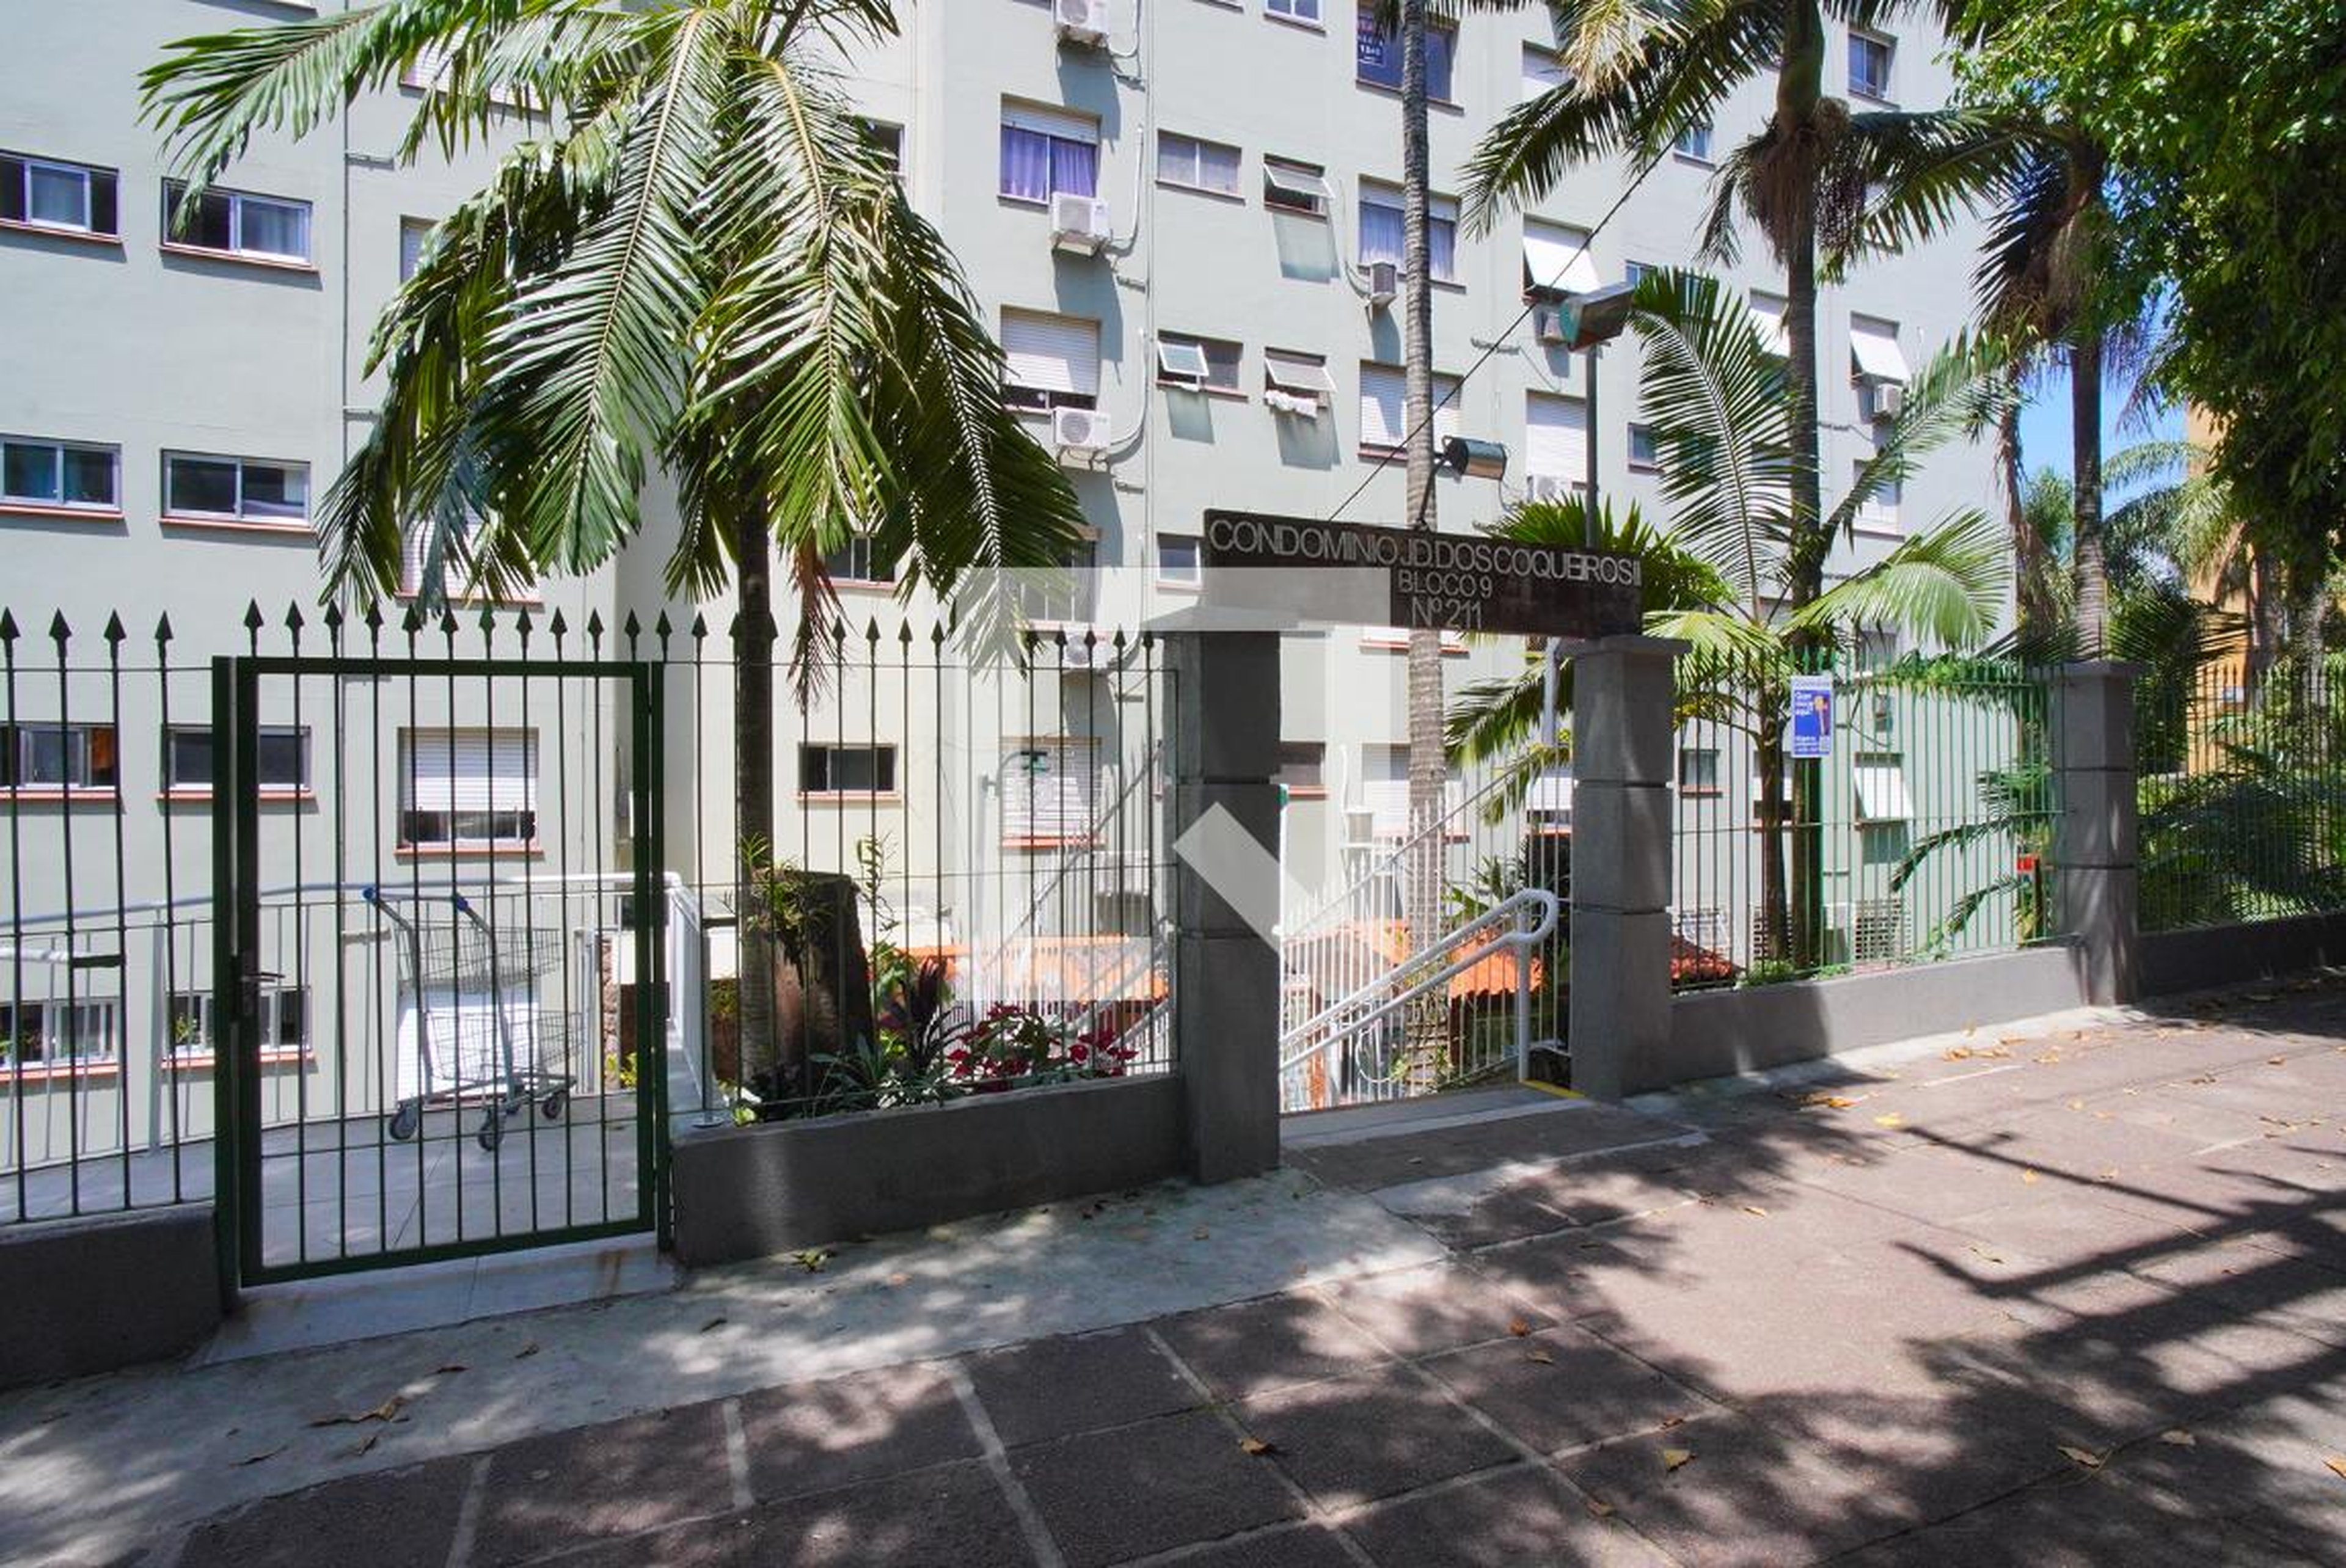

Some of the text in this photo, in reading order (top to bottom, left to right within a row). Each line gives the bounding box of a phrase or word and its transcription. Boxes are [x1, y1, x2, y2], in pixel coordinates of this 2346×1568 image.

[1210, 519, 1398, 565] CONDOMINIO
[1435, 540, 1493, 573] DOS
[1494, 546, 1632, 585] COQUEIROS
[1398, 569, 1493, 599] BLOCO 9
[1445, 598, 1482, 630] 211
